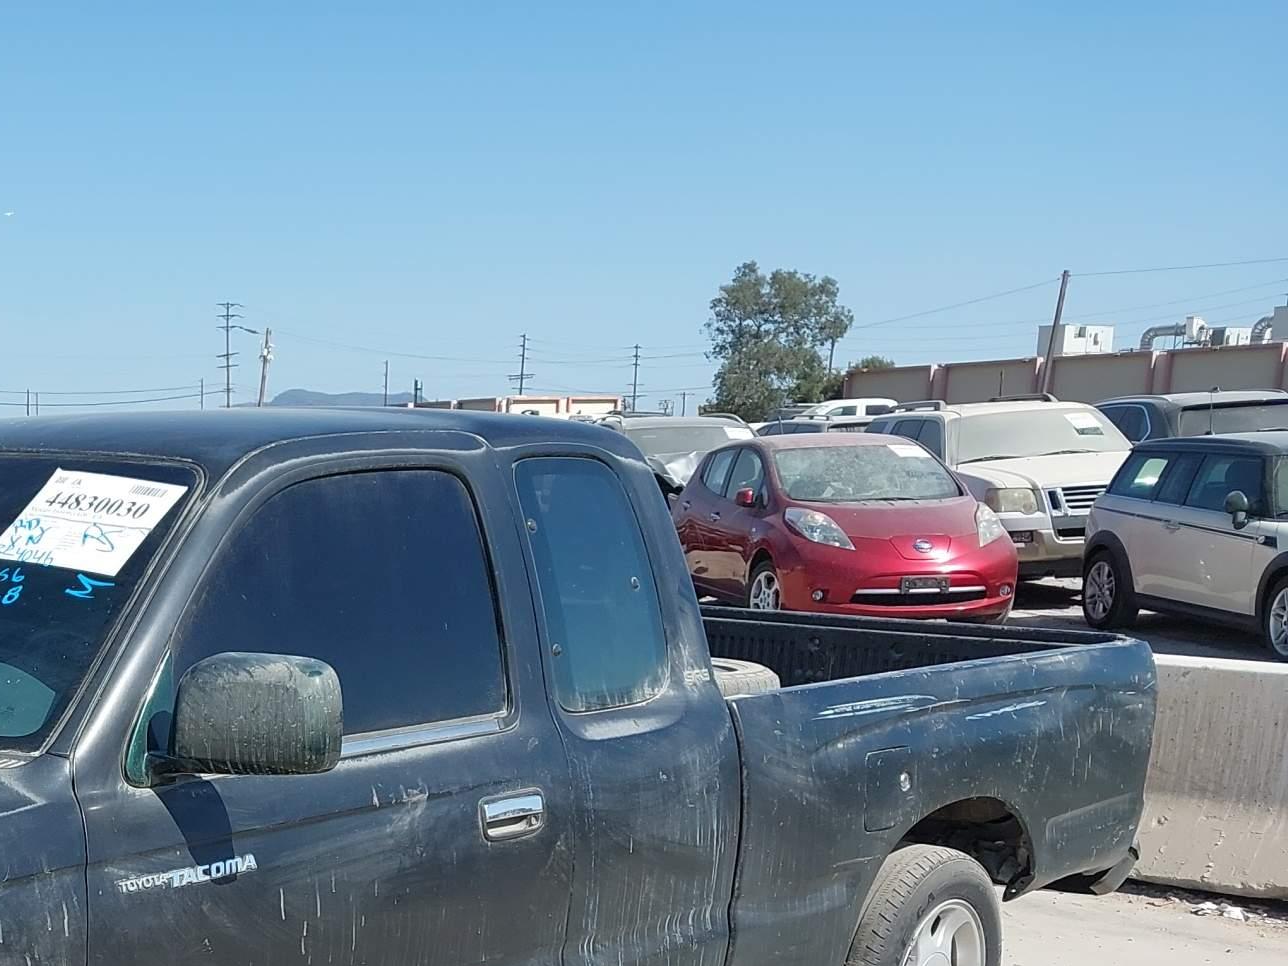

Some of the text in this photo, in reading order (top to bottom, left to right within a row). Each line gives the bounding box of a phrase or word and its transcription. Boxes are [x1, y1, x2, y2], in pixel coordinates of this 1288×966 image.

[45, 491, 151, 519] 44830030
[117, 852, 258, 894] TOYOTA TACOMA
